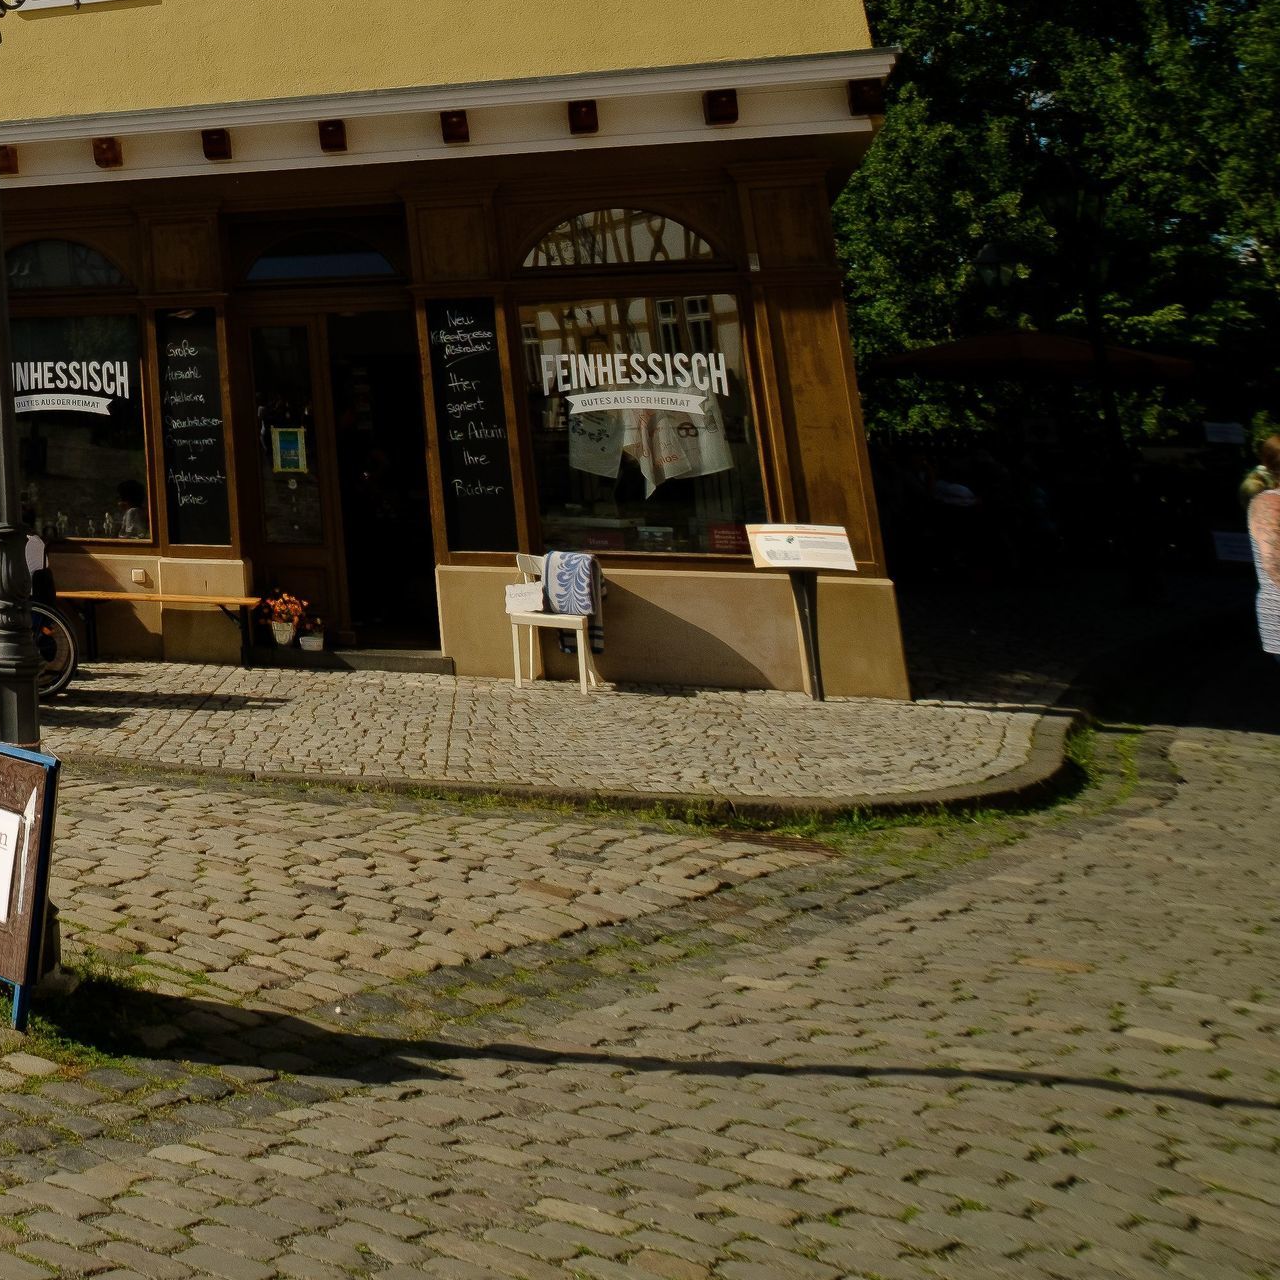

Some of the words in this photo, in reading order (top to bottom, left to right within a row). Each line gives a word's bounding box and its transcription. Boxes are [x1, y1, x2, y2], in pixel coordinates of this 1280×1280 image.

[448, 371, 481, 393] Hier
[540, 352, 729, 397] FEINHESSISCH
[41, 397, 55, 407] AUS
[55, 397, 71, 407] DER
[71, 398, 101, 409] HEIMAT
[446, 397, 485, 419] signiert
[581, 396, 611, 407] GUTES
[613, 395, 633, 405] AUS
[634, 395, 653, 405] DER
[654, 396, 691, 408] HEIMAT
[462, 448, 491, 467] Ihre
[451, 478, 506, 498] Bücher
